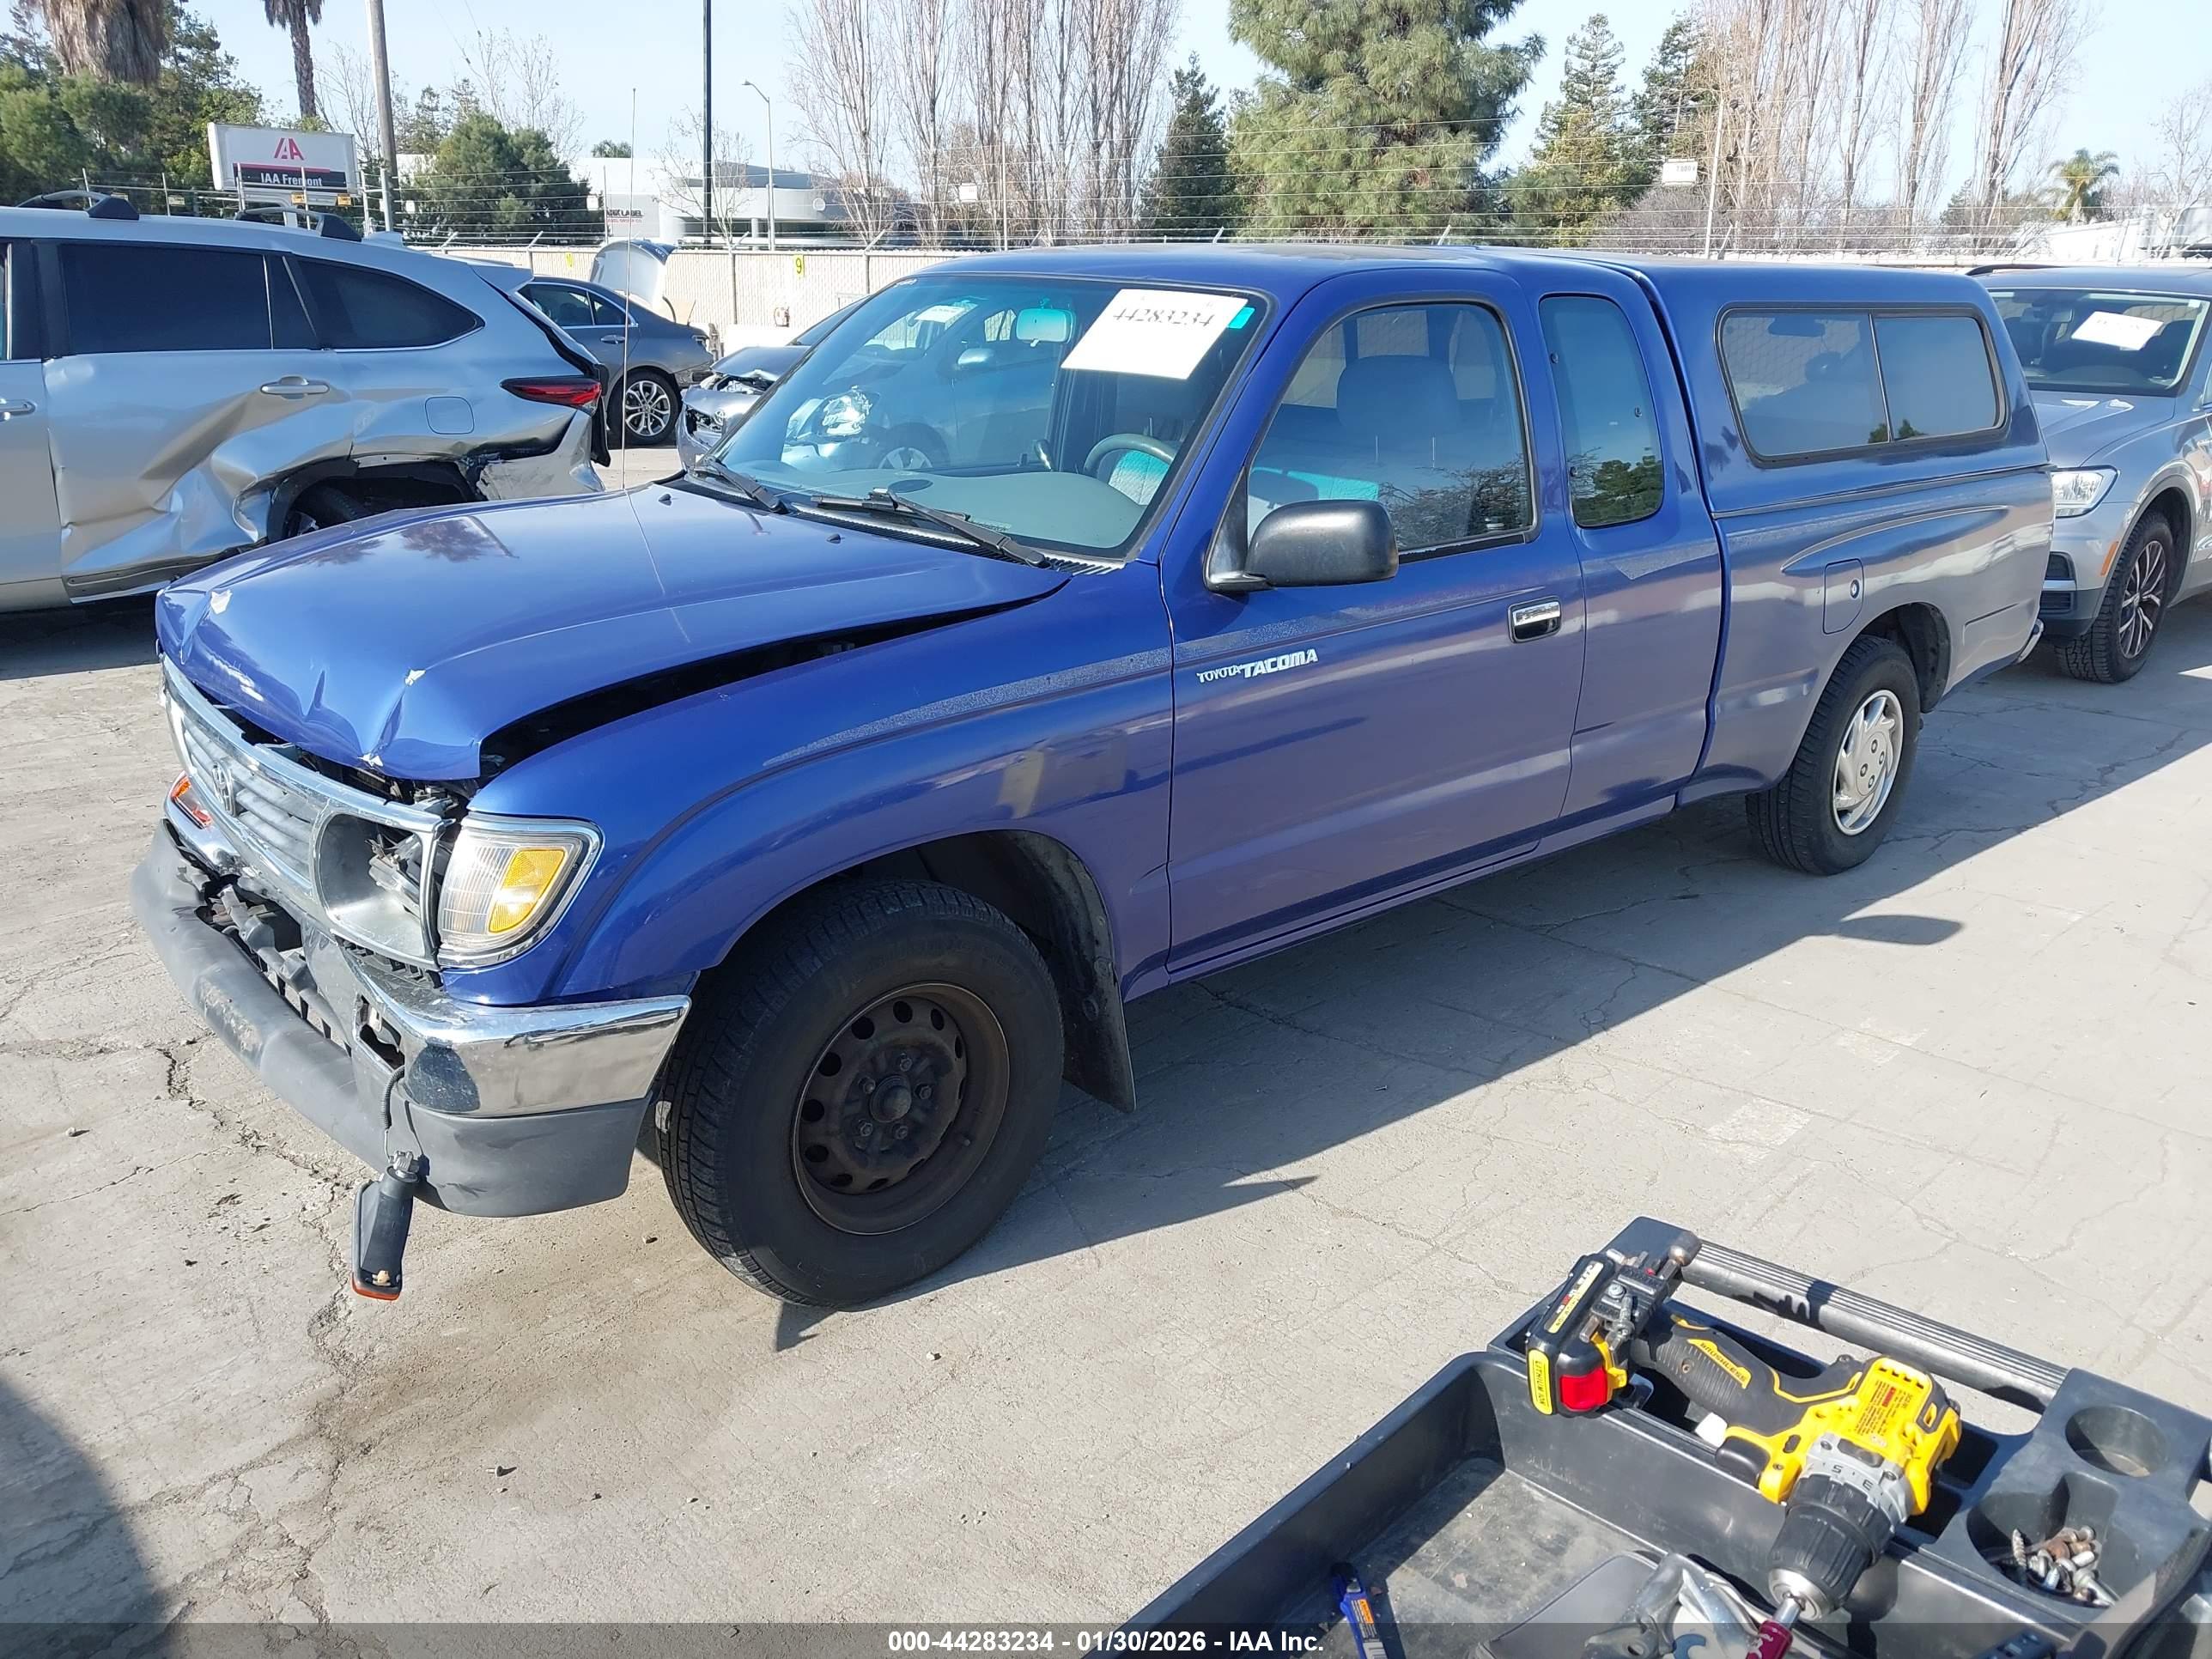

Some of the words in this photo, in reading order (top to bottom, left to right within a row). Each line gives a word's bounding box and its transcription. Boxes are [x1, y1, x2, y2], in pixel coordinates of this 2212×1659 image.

[260, 172, 281, 184] IAA
[795, 258, 802, 274] 9
[1113, 307, 1216, 327] 44283234
[1196, 665, 1242, 684] TOYOTA
[1243, 648, 1318, 678] TACOMA
[1699, 1342, 1748, 1382] BRUSHLESS
